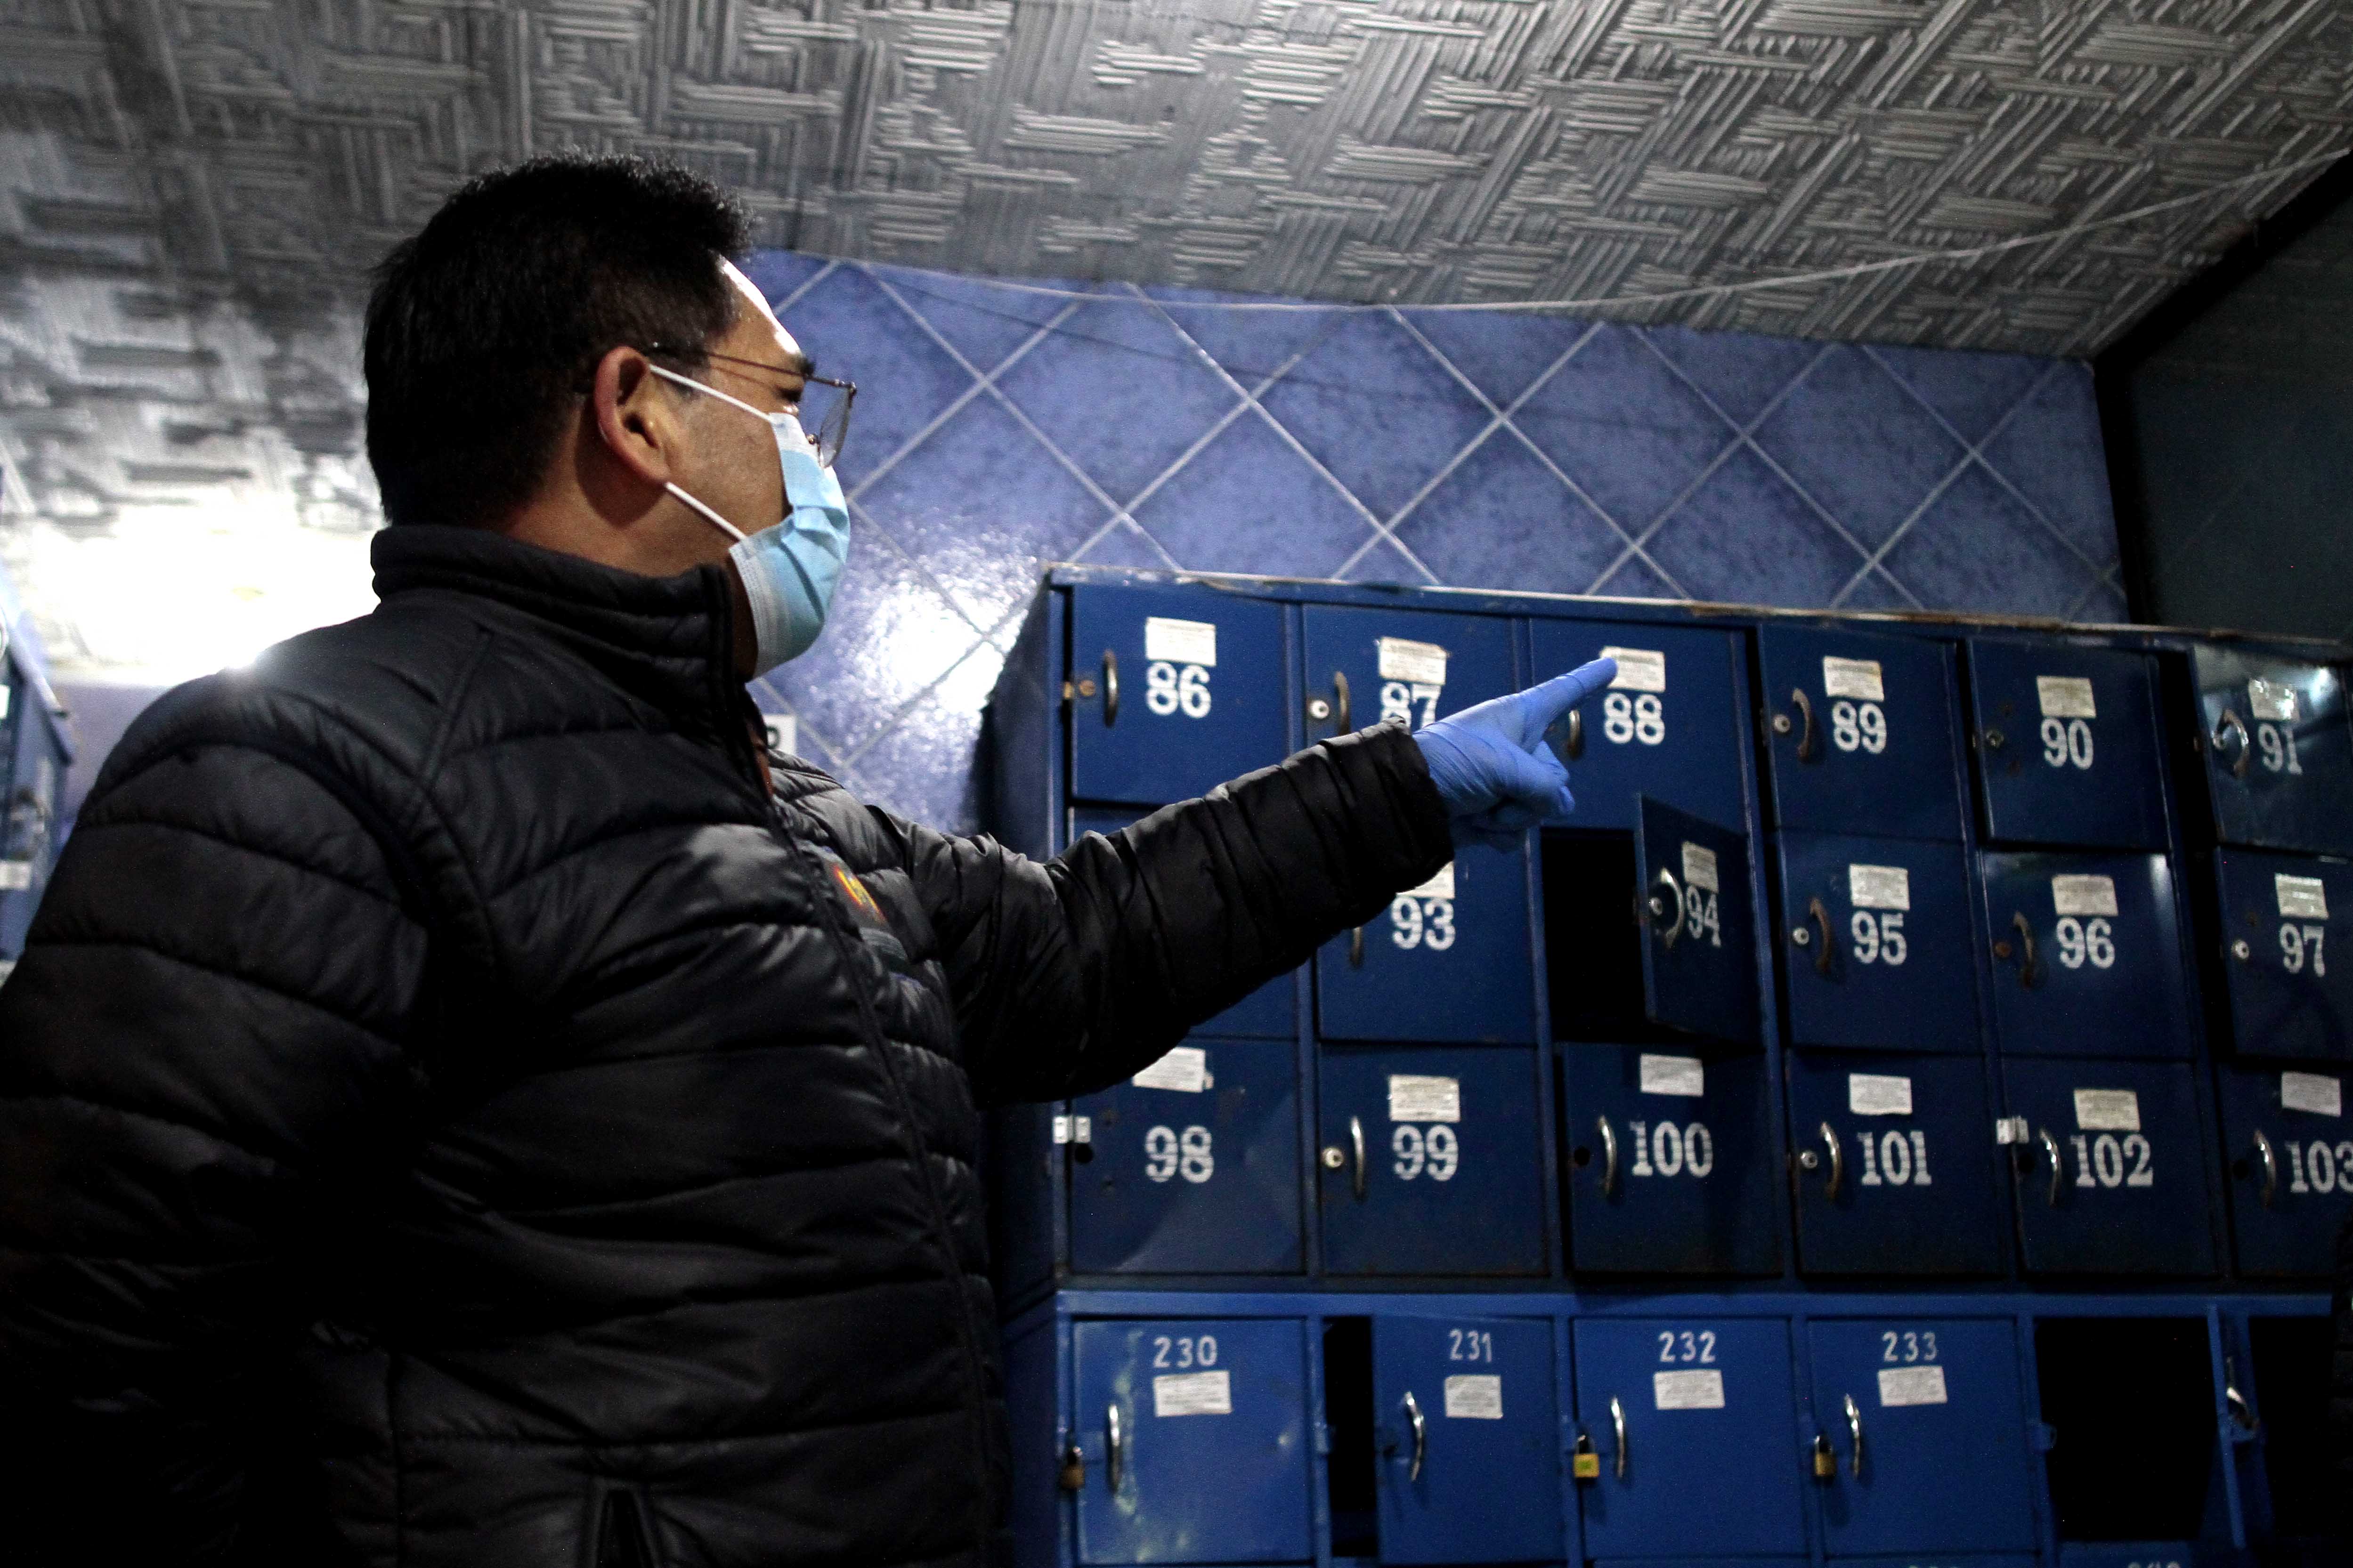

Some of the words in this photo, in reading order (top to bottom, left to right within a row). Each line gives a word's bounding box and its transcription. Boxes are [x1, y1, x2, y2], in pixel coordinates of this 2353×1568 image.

[1146, 661, 1212, 718] 86
[1381, 682, 1441, 731] 87
[1604, 693, 1665, 745] 88
[1832, 701, 1887, 754] 89
[2040, 718, 2093, 769] 90
[2258, 723, 2302, 775] 91
[1391, 896, 1456, 951] 93
[1687, 886, 1721, 947] 94
[1851, 911, 1907, 966] 95
[2056, 917, 2116, 969] 96
[2279, 922, 2326, 978] 97
[1144, 1125, 1215, 1184] 98
[1392, 1124, 1459, 1181] 99
[1629, 1120, 1713, 1178] 100
[1858, 1129, 1932, 1187] 101
[2070, 1133, 2154, 1188] 102
[1152, 1334, 1217, 1368] 230
[1448, 1329, 1493, 1363] 231
[1658, 1330, 1717, 1363] 232
[1882, 1331, 1939, 1362] 233
